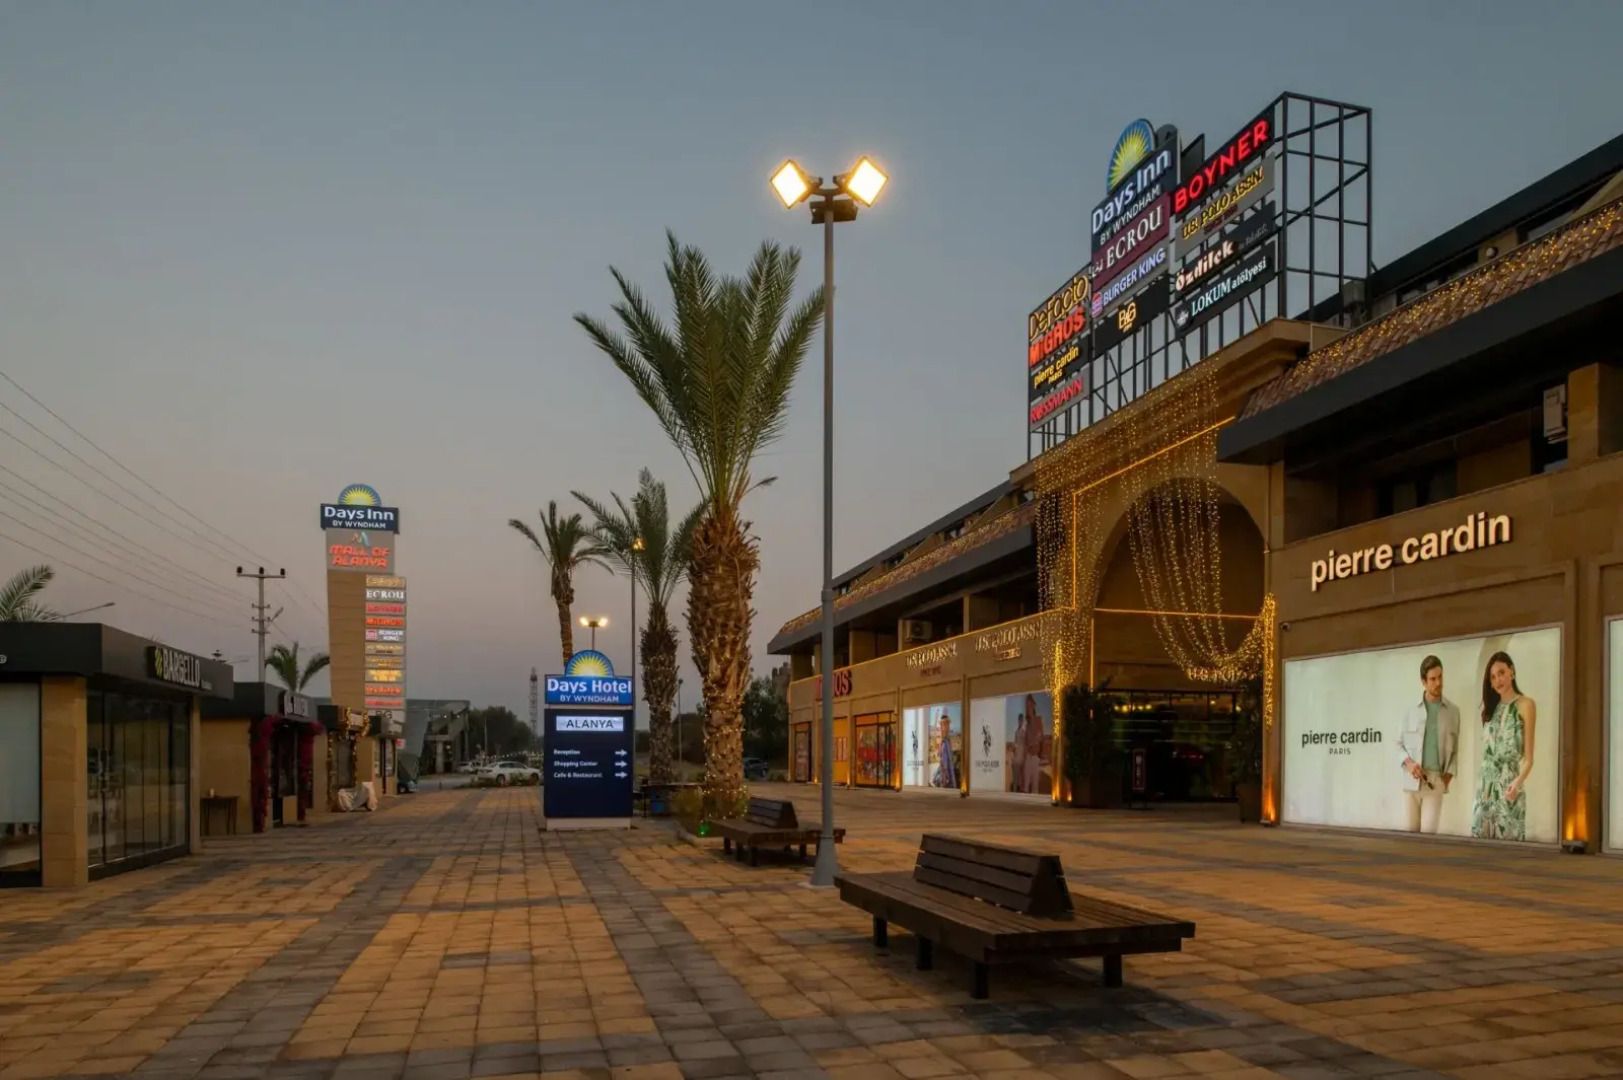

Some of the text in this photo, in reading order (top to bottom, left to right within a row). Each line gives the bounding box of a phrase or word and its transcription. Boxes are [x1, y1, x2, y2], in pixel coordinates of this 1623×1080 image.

[1174, 119, 1269, 214] BOYNER
[1092, 149, 1172, 235] Days Inn
[1100, 230, 1112, 246] BY
[1112, 183, 1161, 238] WYNDHAM
[1106, 203, 1164, 269] ECROU
[1103, 269, 1138, 307] BURGER
[1138, 246, 1166, 282] KING
[1175, 239, 1234, 291] Özdilek
[1190, 255, 1267, 317] LOKUM atölyesi
[1034, 346, 1079, 389] pierre cardin
[1030, 375, 1084, 424] ROSSMANN
[324, 506, 394, 521] Days Inn
[332, 519, 386, 529] BY WYNDHAM
[1311, 511, 1511, 592] pierre cardin
[366, 590, 404, 599] ECROU
[163, 648, 200, 688] BARGELLO
[547, 678, 632, 694] Days Hotel
[559, 694, 619, 703] BY WYNDHAM
[566, 719, 614, 729] ALANYA
[1301, 727, 1382, 748] pierre cardin
[1328, 747, 1352, 756] PARIS
